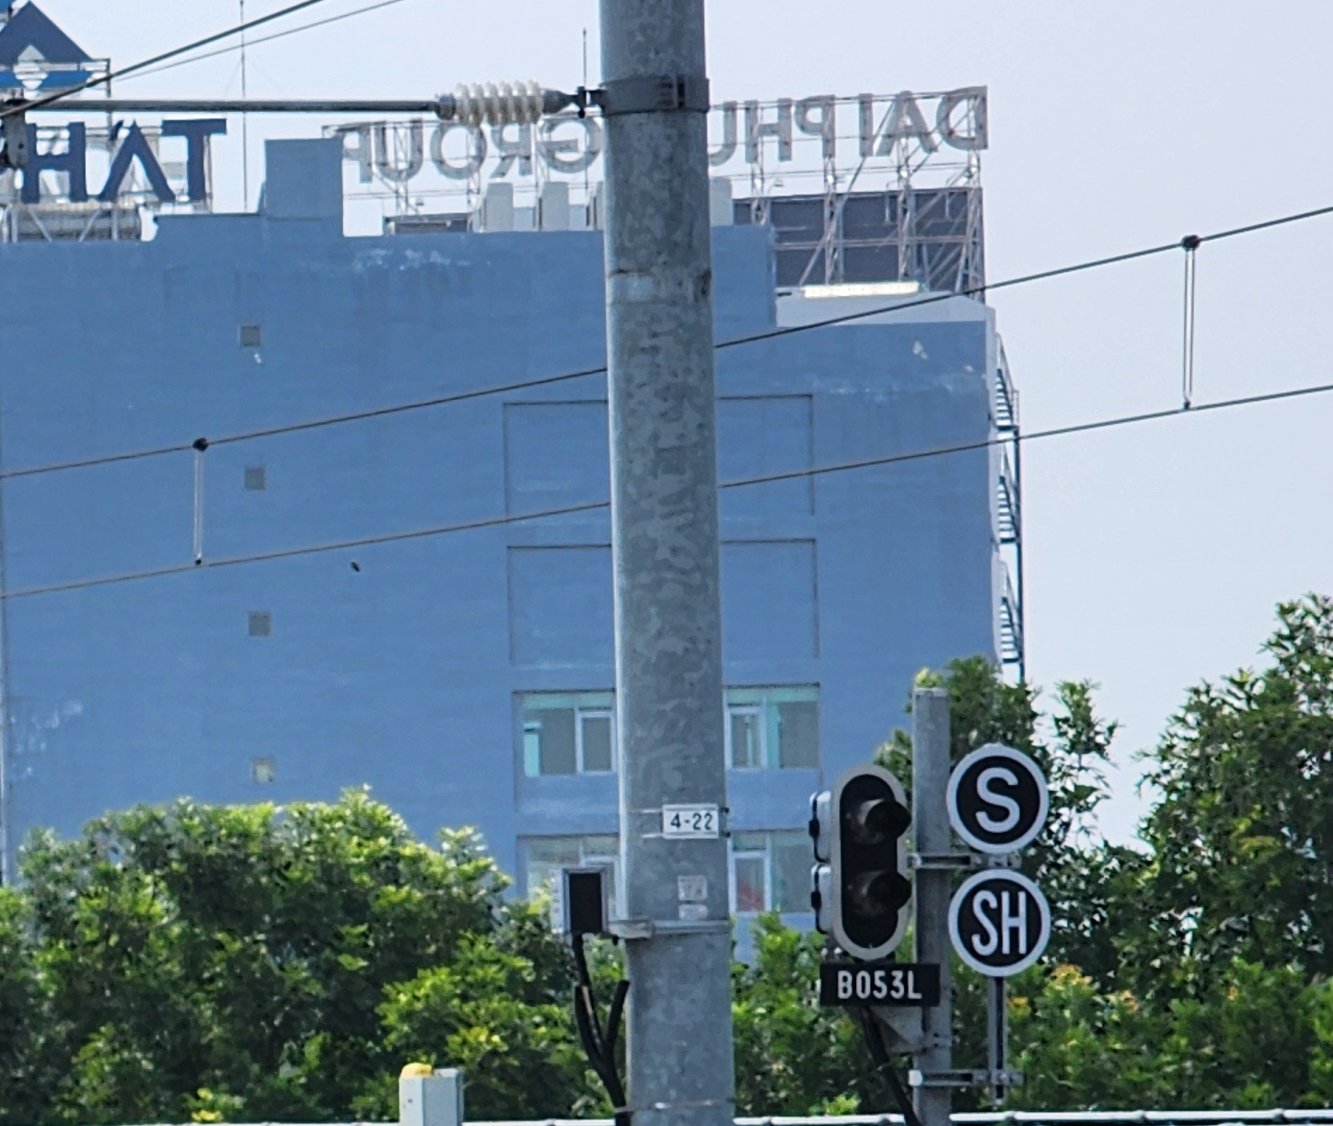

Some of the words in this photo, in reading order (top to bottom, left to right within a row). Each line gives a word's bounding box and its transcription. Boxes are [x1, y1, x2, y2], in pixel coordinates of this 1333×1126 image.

[670, 811, 713, 830] 4-22
[976, 766, 1021, 833] S
[971, 890, 1027, 956] SH
[836, 969, 923, 1000] B053L
